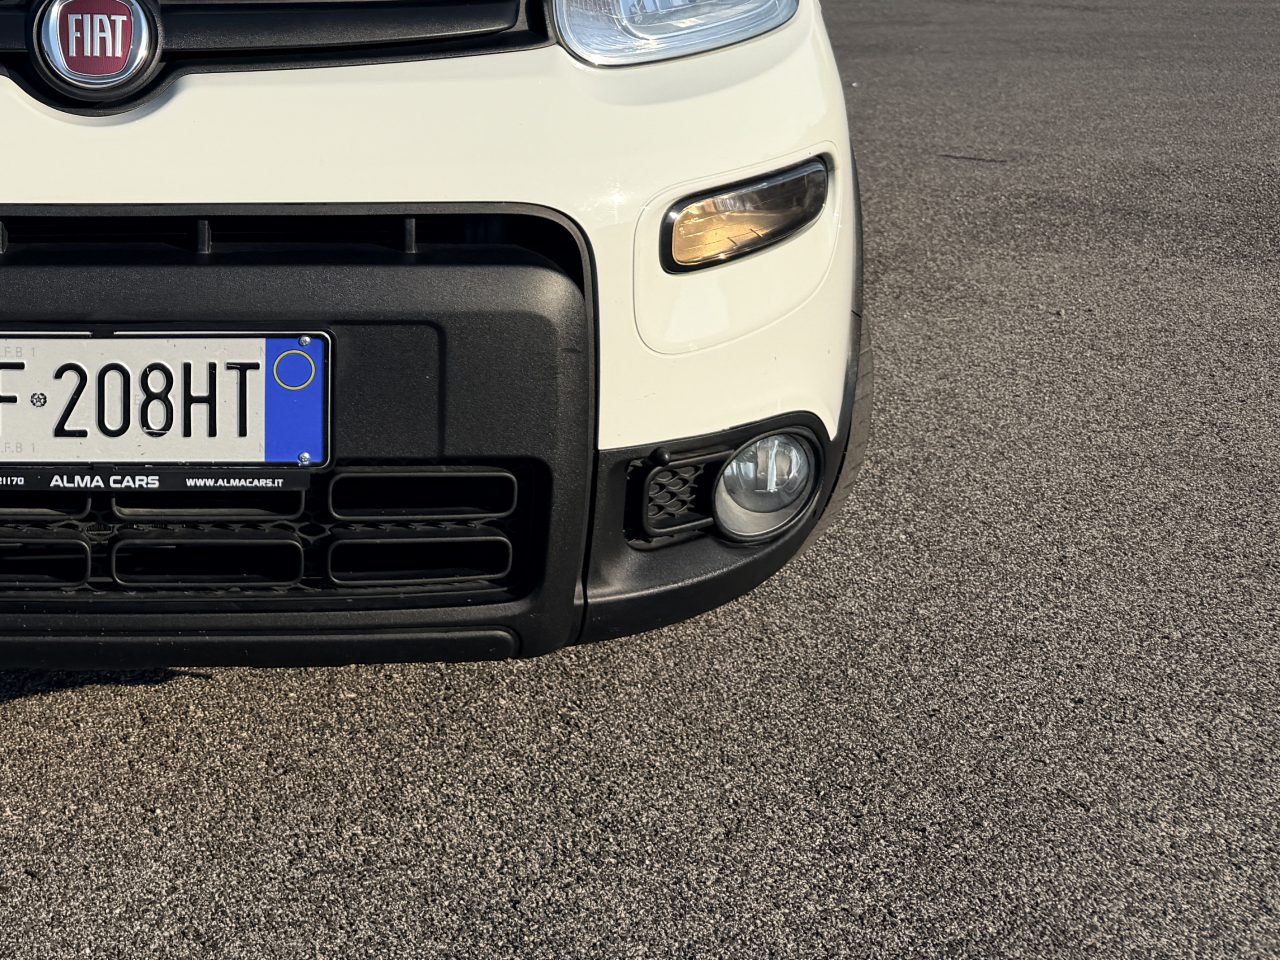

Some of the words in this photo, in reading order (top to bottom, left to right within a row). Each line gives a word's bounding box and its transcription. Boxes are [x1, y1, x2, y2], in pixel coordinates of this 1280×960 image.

[67, 13, 128, 58] FIAT
[52, 361, 261, 438] 208HT
[49, 474, 105, 488] ALMA
[109, 475, 160, 489] CARS
[185, 478, 284, 488] WWW.ALMACARS.IT
